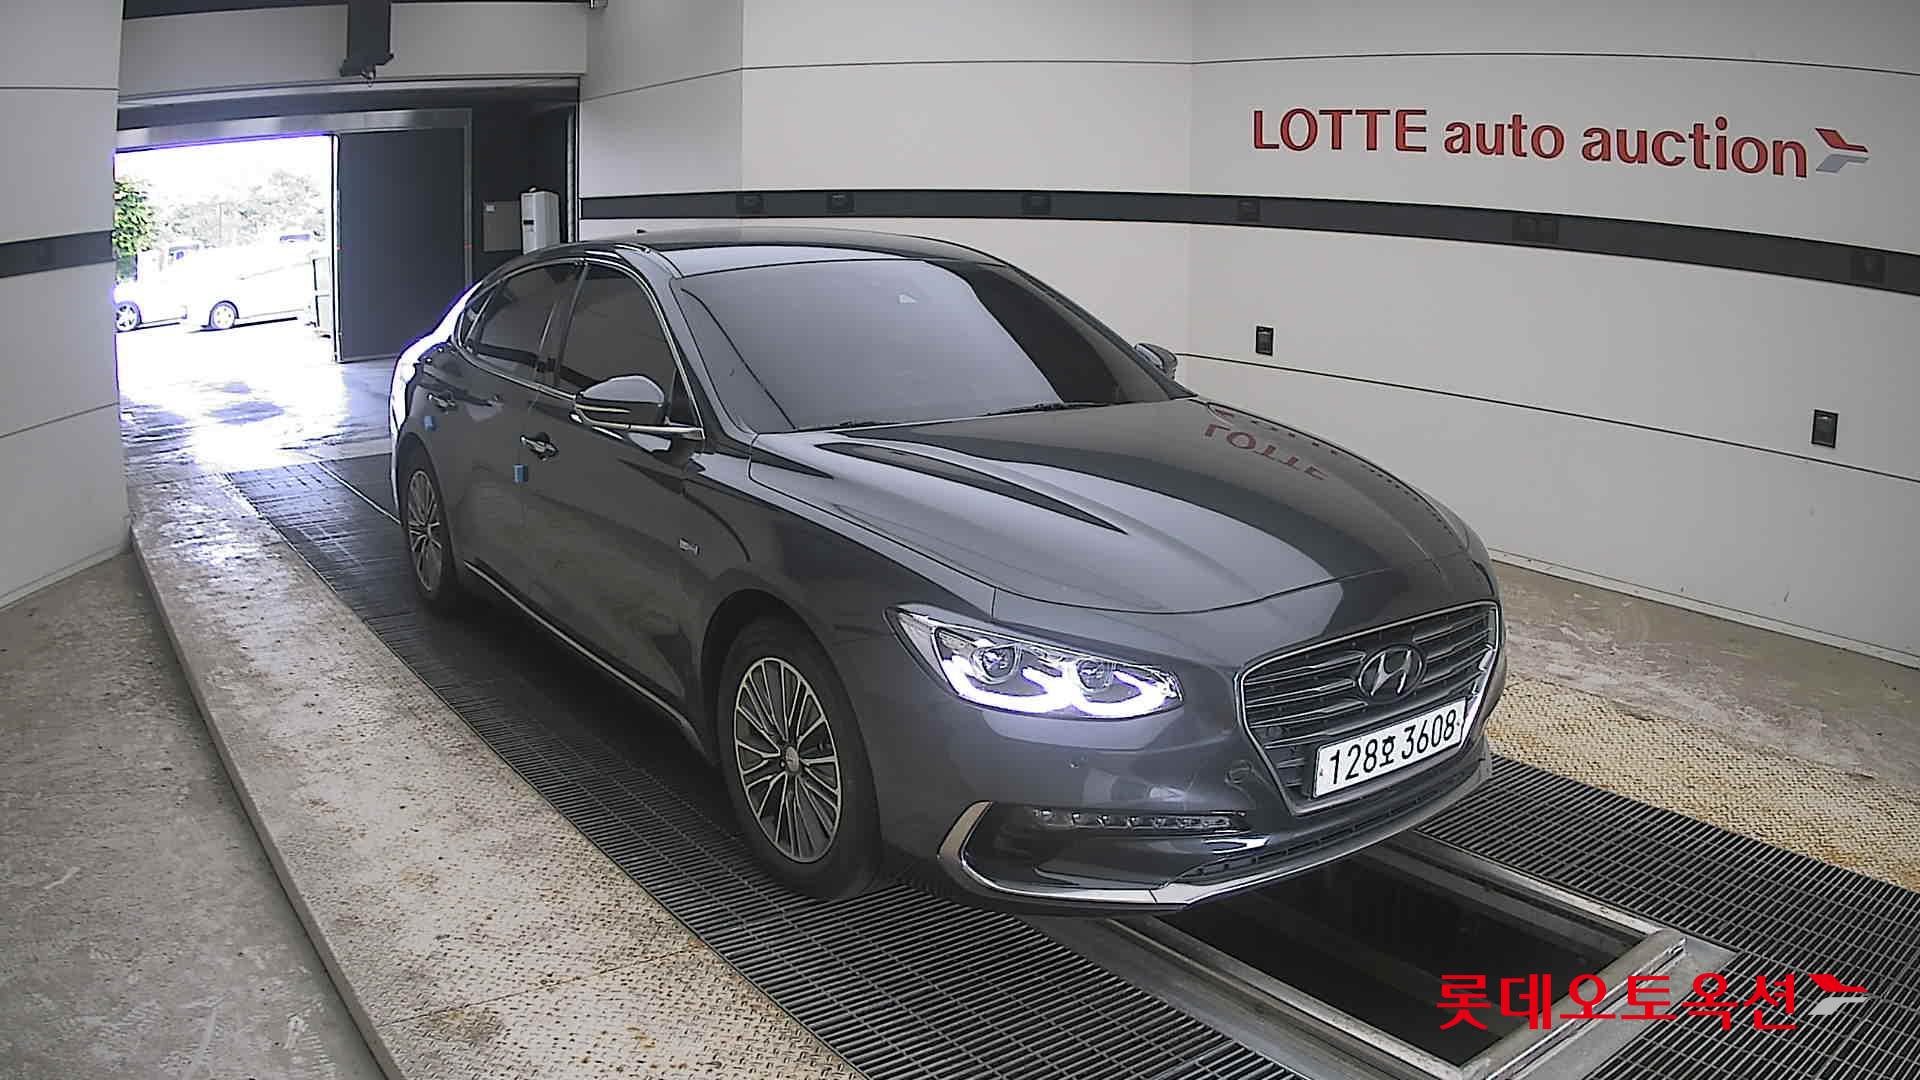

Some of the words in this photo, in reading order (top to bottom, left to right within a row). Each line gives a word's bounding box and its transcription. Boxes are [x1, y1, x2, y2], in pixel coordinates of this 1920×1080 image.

[1253, 108, 1427, 153] LOTTE
[1444, 114, 1566, 158] auto
[1582, 116, 1808, 178] auction
[1401, 709, 1457, 760] 3608
